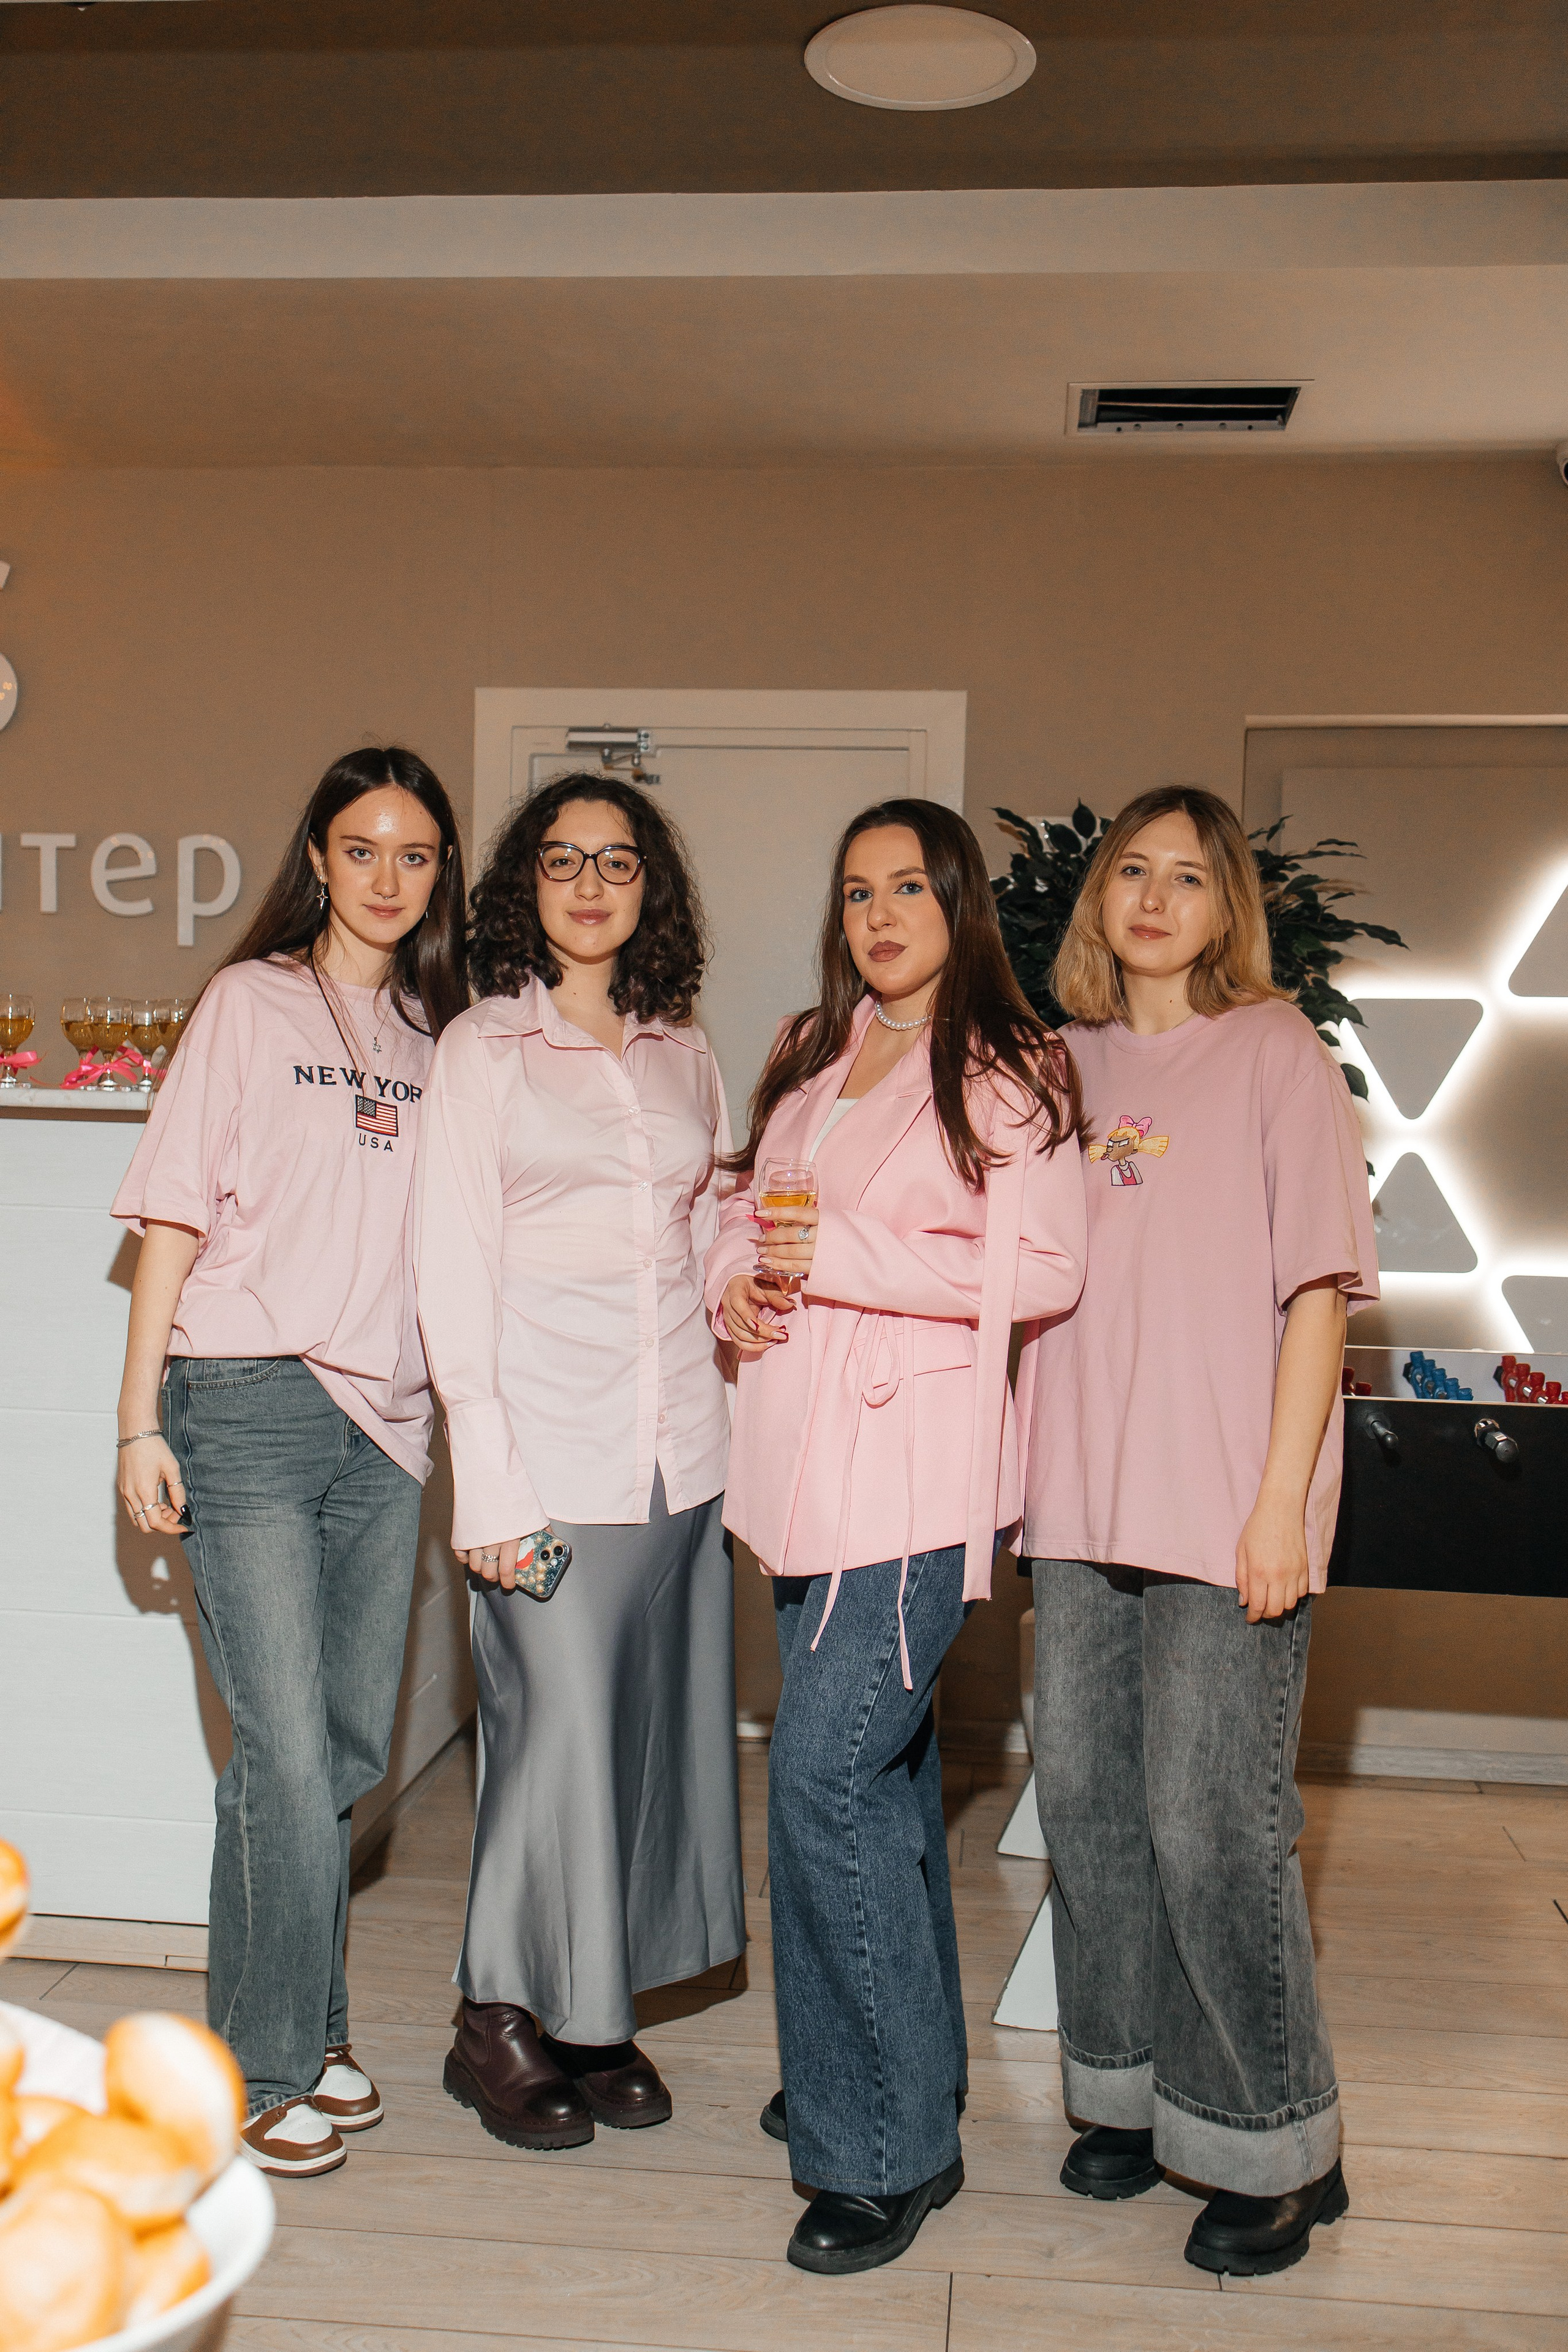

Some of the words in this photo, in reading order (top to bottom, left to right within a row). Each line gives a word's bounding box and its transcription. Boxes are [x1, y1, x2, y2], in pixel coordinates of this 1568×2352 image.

[0, 832, 241, 947] тер
[293, 1065, 366, 1089] NEW
[374, 1076, 423, 1103] YOR
[358, 1133, 393, 1152] USA
